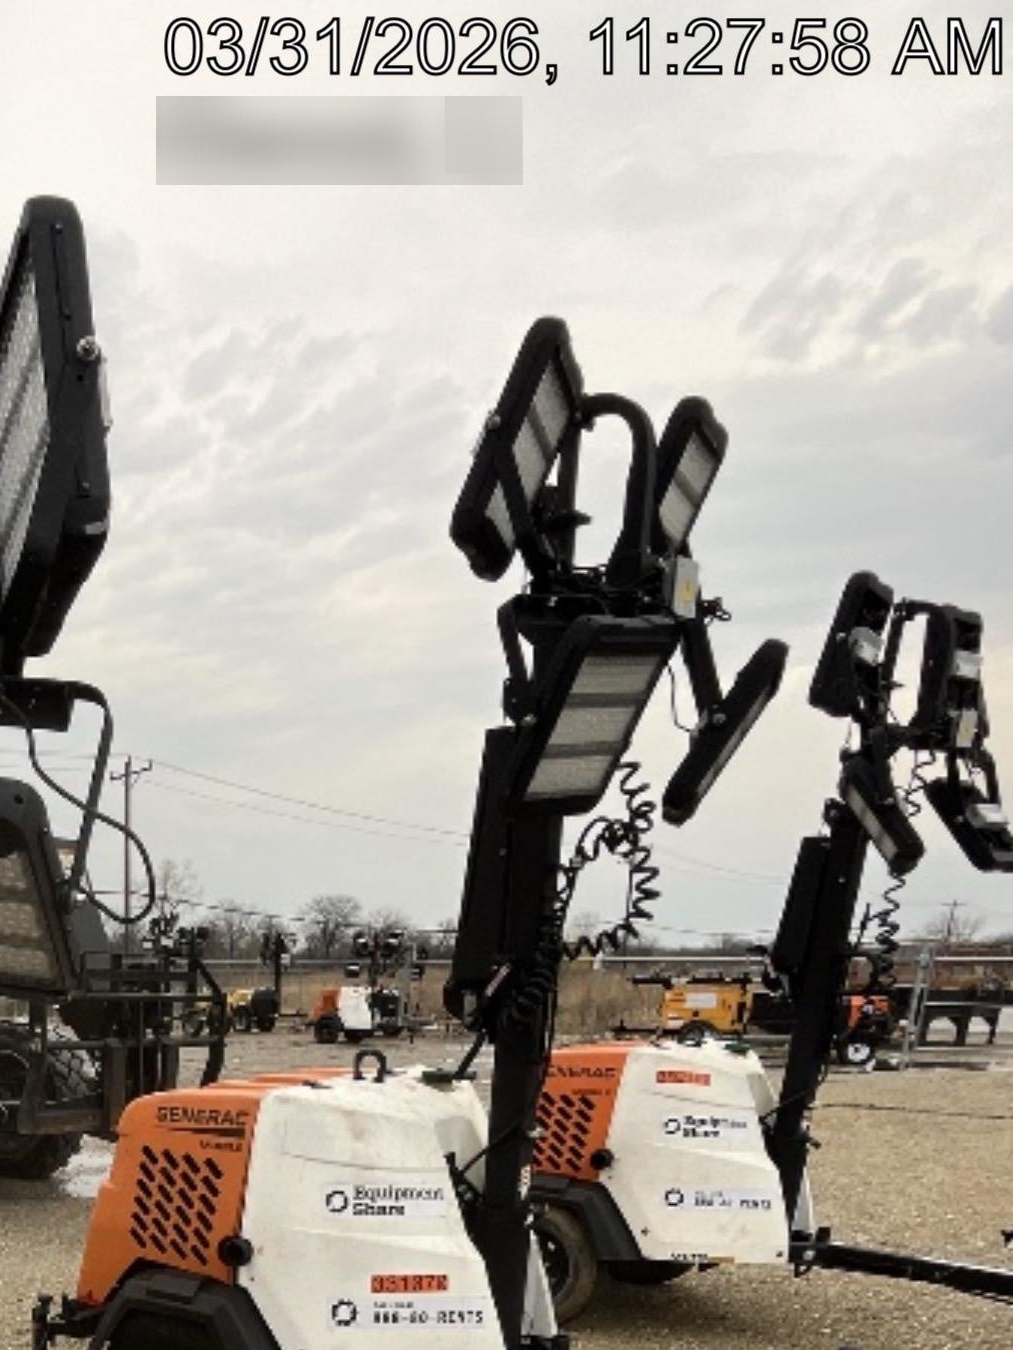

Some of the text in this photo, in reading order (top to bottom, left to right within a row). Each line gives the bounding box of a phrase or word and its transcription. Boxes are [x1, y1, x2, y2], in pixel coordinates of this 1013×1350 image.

[157, 1106, 250, 1126] GENERAC
[352, 1185, 444, 1203] Equipment
[353, 1203, 405, 1216] Share
